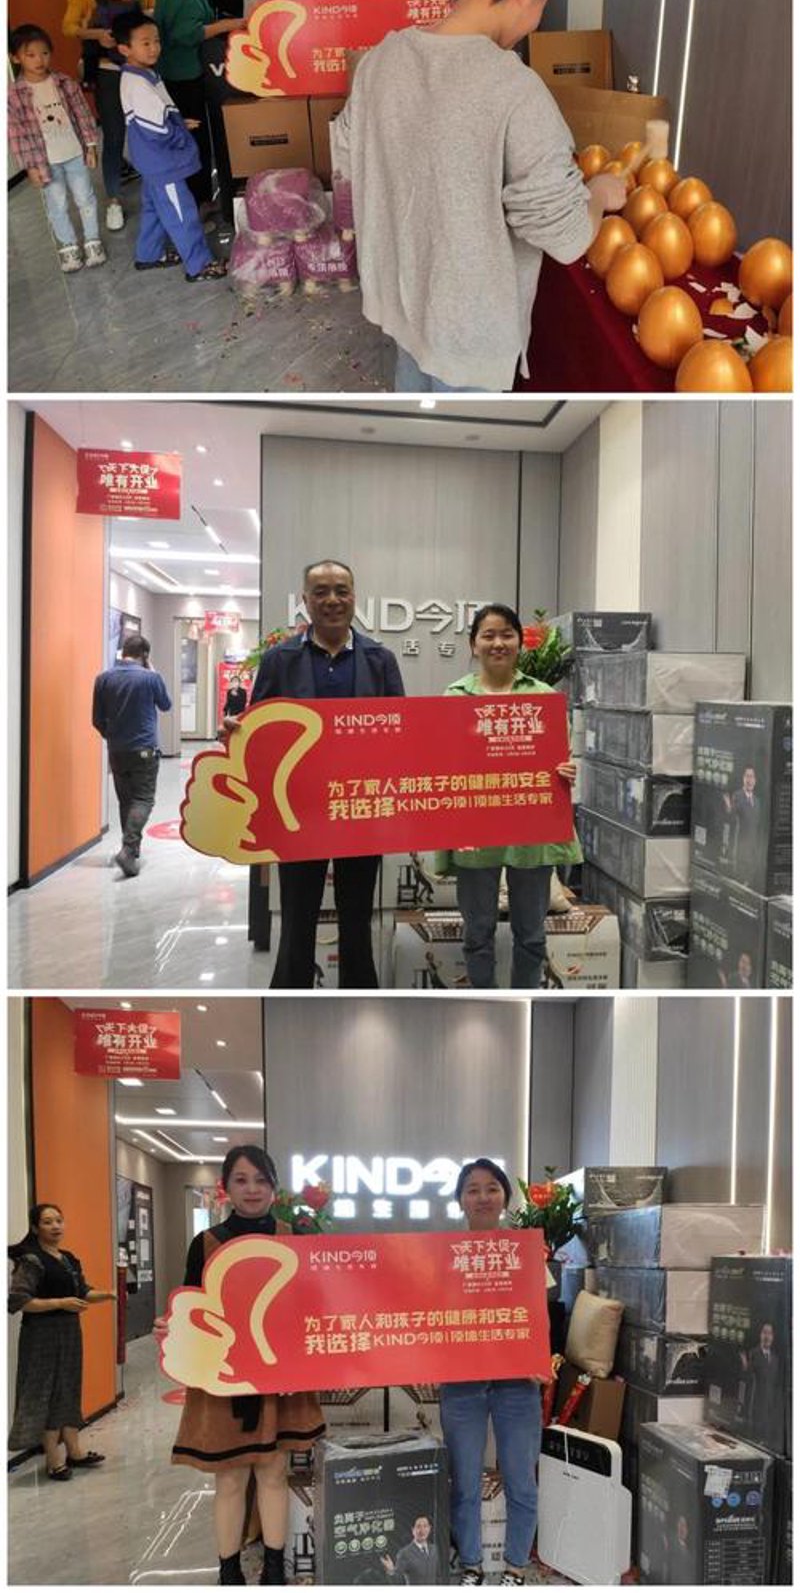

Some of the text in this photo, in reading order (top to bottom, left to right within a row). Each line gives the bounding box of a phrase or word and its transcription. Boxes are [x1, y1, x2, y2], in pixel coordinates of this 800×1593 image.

[334, 713, 400, 728] KIND今顶
[476, 716, 545, 737] 唯有开业
[328, 771, 552, 799] 为了家人和孩子的健康和安全
[310, 1250, 377, 1264] KIND今顶
[453, 1252, 522, 1273] 唯有开业
[304, 1306, 529, 1333] 为了家人和孩子的健康和安全
